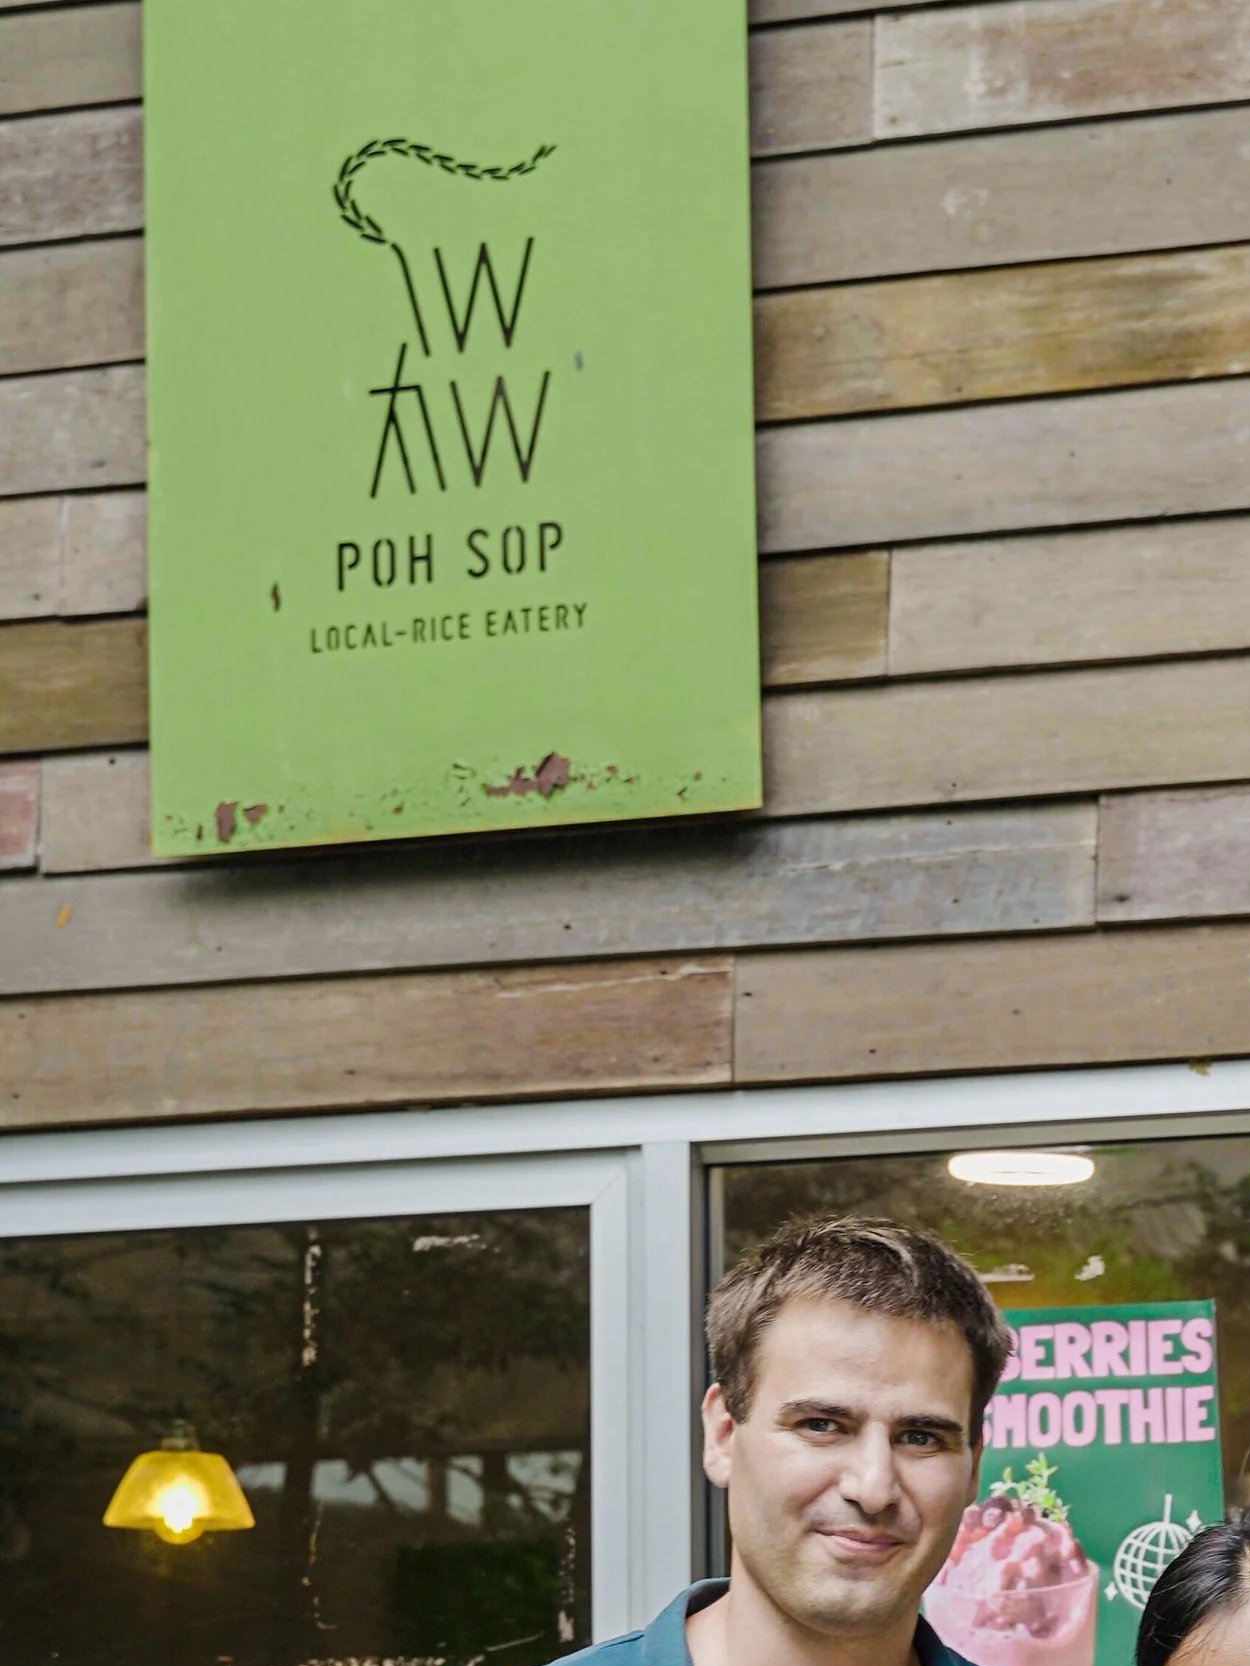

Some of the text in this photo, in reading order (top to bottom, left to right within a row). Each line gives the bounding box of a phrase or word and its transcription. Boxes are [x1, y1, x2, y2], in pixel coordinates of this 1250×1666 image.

[337, 521, 563, 592] POH SOP
[309, 602, 588, 654] LOCAL-RICE EATERY
[983, 1385, 1216, 1448] MOOTHIE
